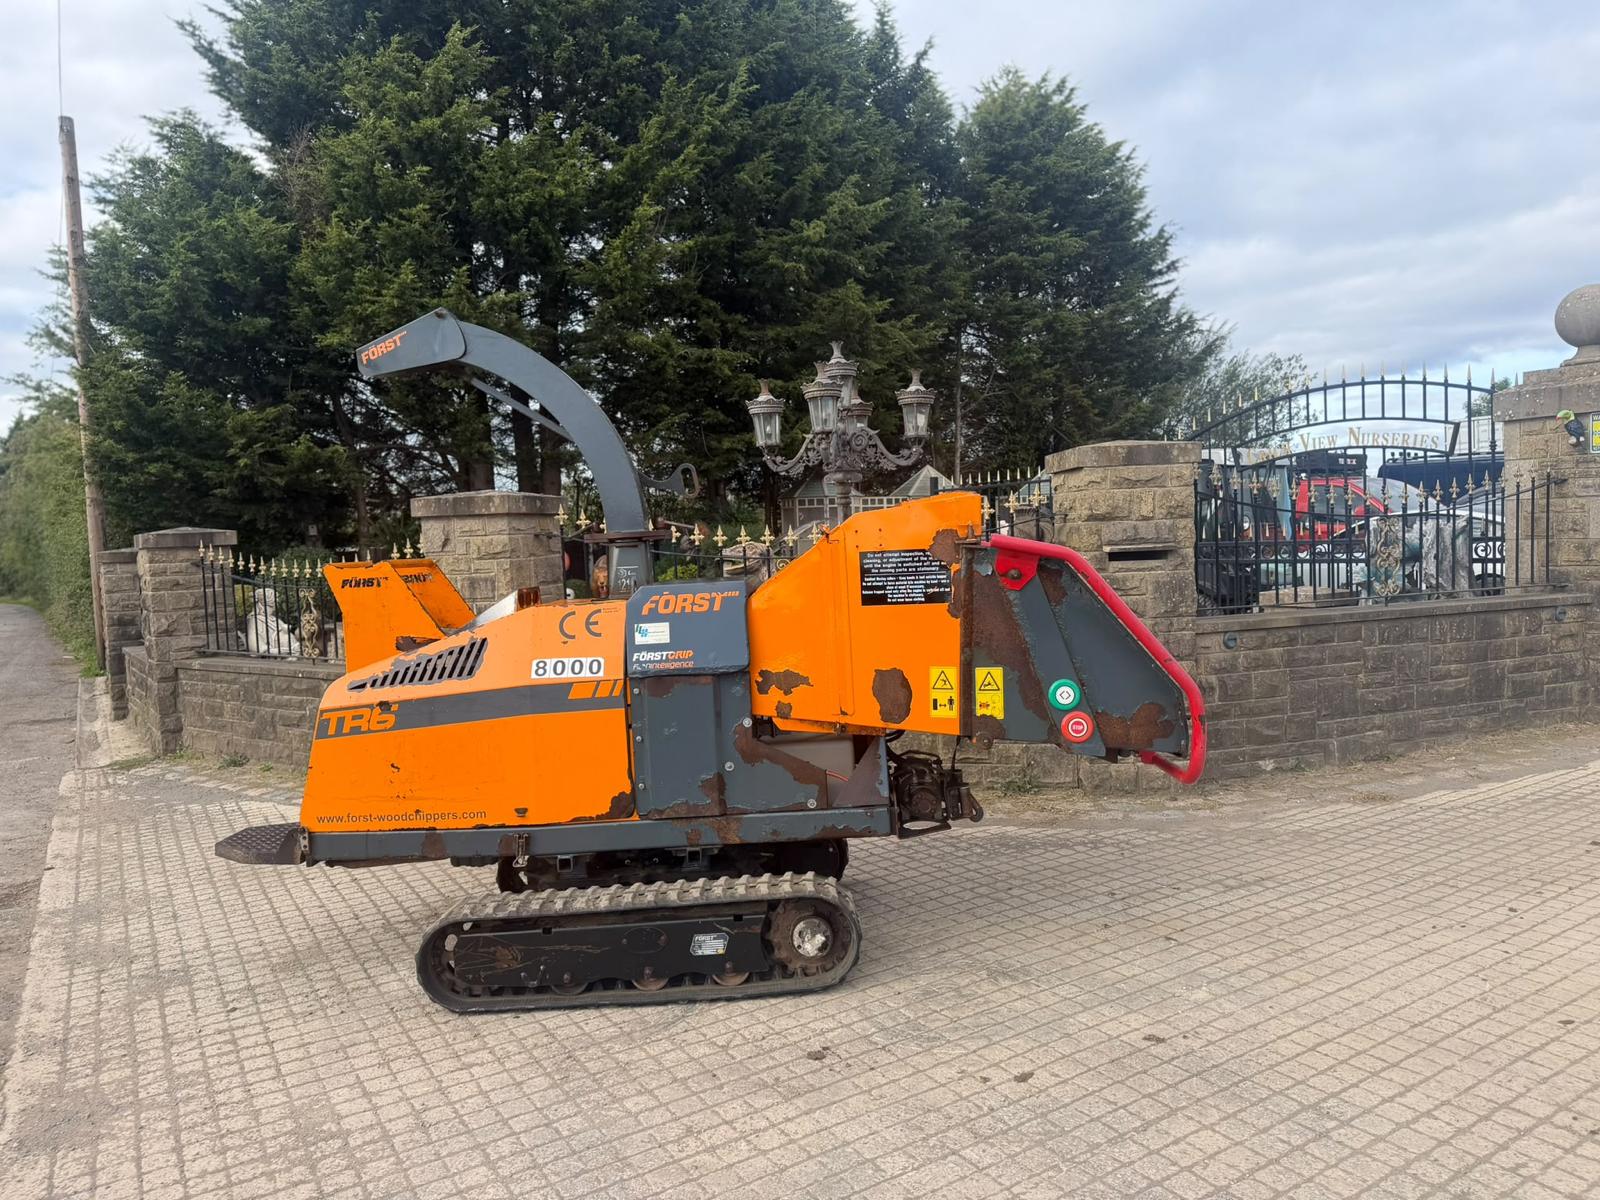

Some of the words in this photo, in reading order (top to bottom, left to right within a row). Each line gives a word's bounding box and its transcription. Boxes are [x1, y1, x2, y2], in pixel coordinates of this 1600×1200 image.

[361, 331, 407, 365] FÖRST
[1299, 432, 1338, 451] VIEW
[1348, 426, 1439, 449] NURSERIES
[641, 591, 740, 616] FÖRST
[559, 608, 602, 640] CE
[534, 659, 602, 677] 8000
[321, 704, 398, 736] TR6
[316, 810, 487, 824] www.forst-woodchippers.com
